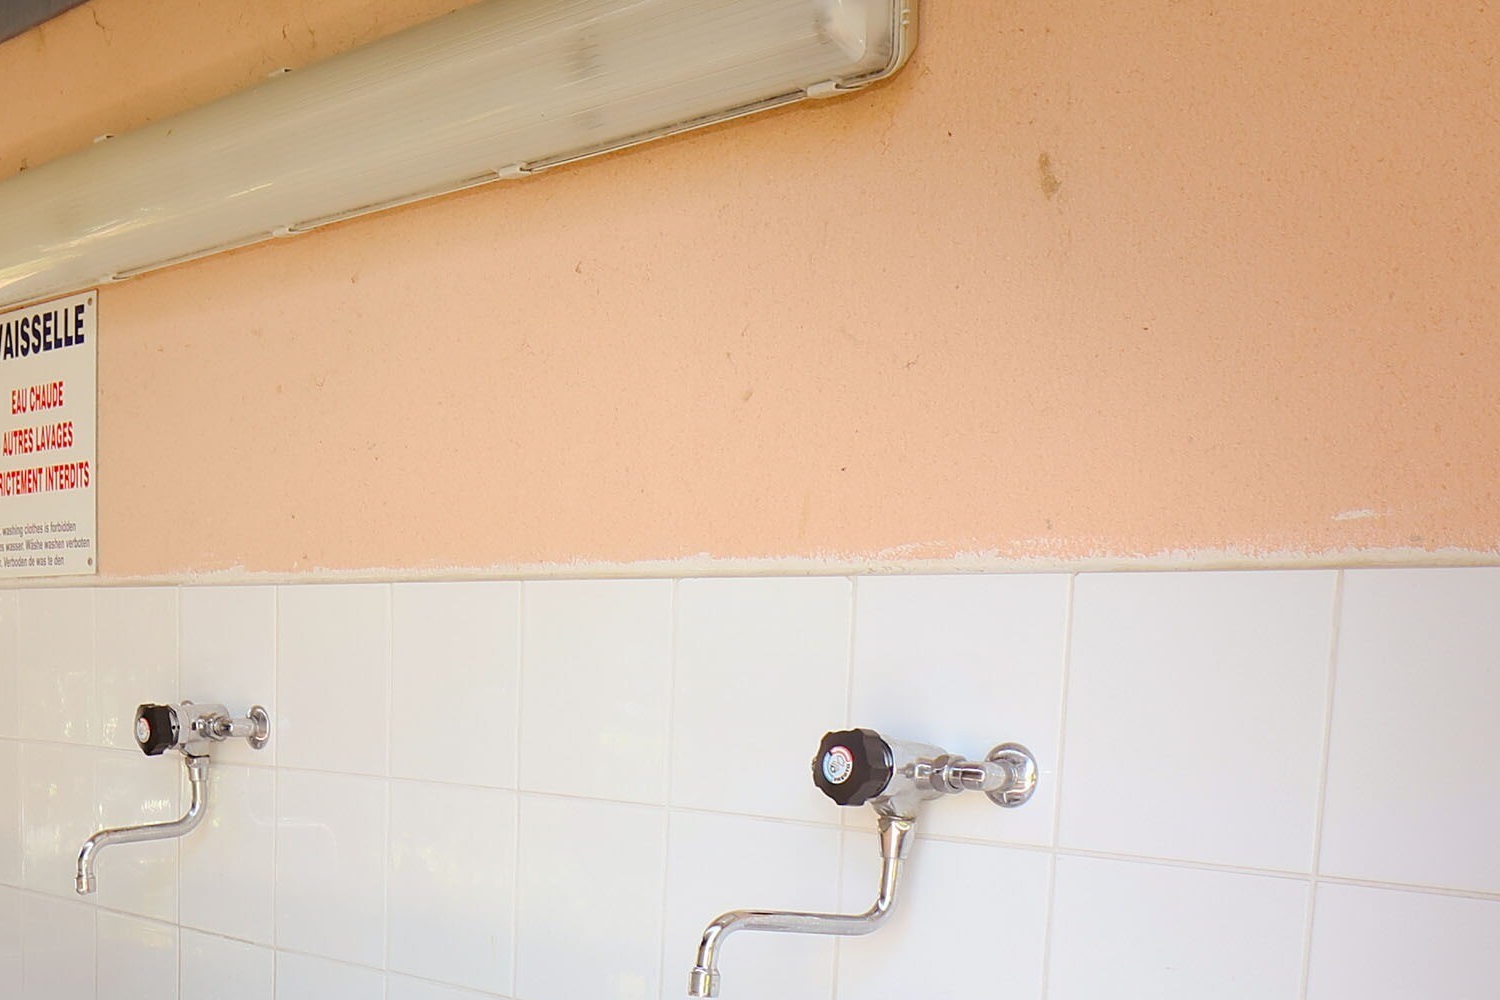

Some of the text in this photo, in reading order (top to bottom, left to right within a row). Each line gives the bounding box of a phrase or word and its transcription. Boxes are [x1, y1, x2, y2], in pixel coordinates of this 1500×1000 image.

[11, 381, 63, 415] EAU CHAUDE
[2, 421, 73, 456] AUTRES LAVAGES
[45, 461, 90, 491] INTERDITS
[3, 524, 23, 538] washing
[24, 523, 43, 535] clothes
[50, 520, 76, 533] forbidden
[66, 536, 90, 548] verboten
[3, 555, 27, 568] Verboden
[28, 554, 35, 566] de
[36, 556, 46, 566] was
[53, 554, 64, 566] den
